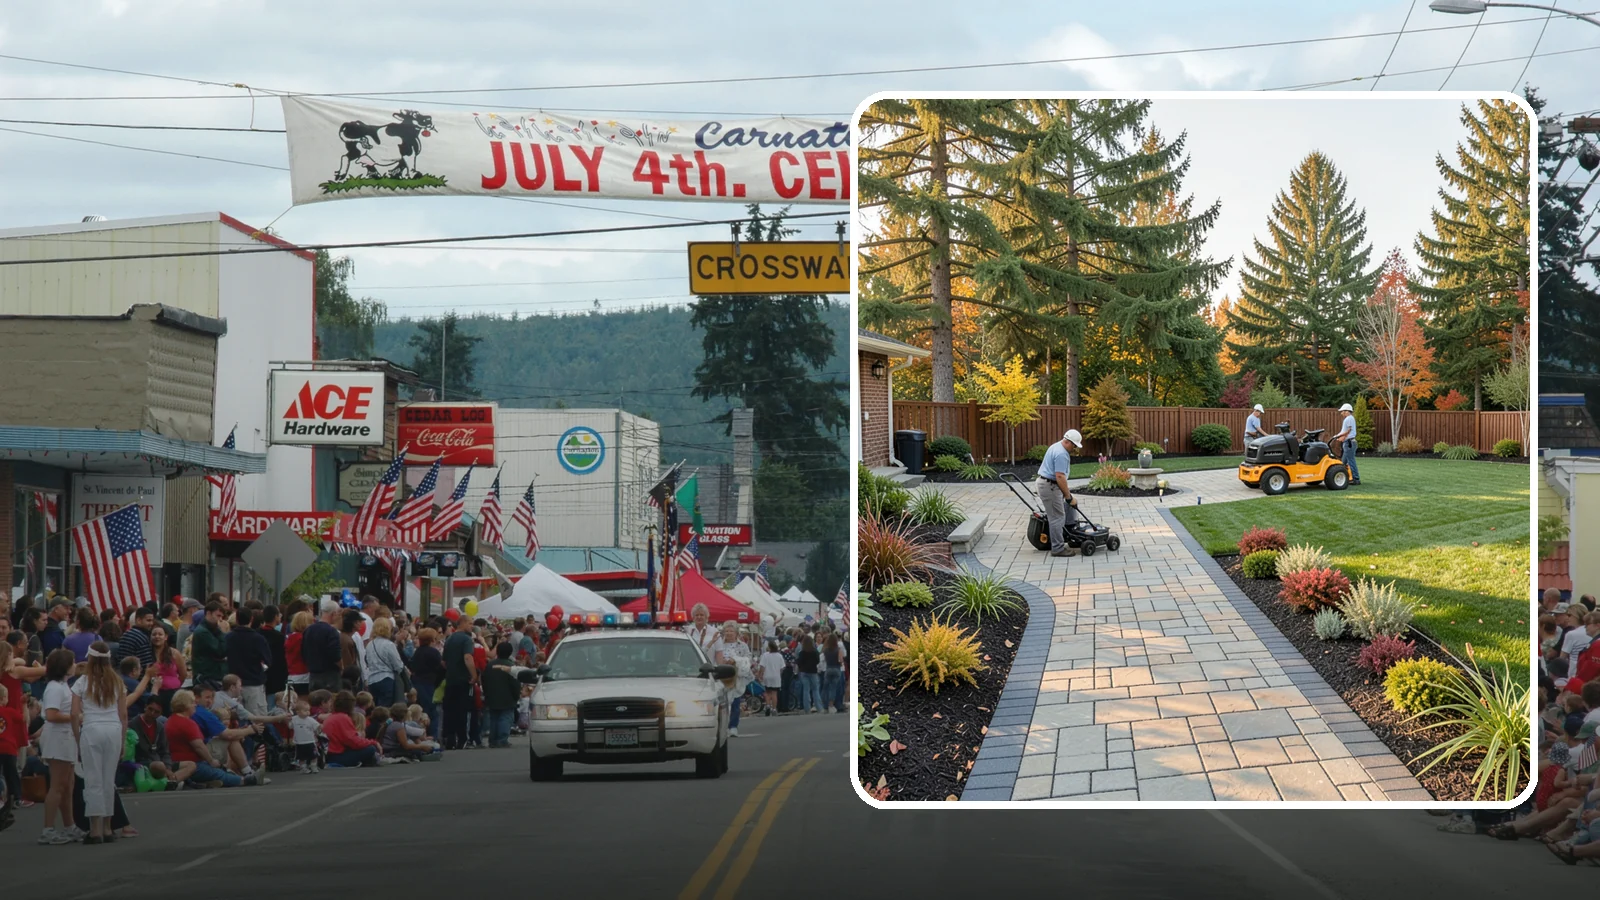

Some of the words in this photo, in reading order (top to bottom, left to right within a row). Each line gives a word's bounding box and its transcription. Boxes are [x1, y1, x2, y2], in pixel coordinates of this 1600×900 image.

[695, 121, 850, 149] Carnat
[481, 141, 605, 192] JULY
[632, 150, 746, 198] 4th.
[697, 254, 850, 280] CROSSWA
[283, 380, 373, 420] ACE
[405, 409, 452, 421] CEDAR
[283, 421, 371, 436] Hardware
[353, 467, 385, 479] Simpl
[95, 485, 124, 495] Vincent
[126, 486, 136, 495] de
[137, 486, 155, 495] Paul
[81, 503, 154, 522] THT
[688, 526, 741, 535] CRNATION
[699, 535, 730, 543] GLASS
